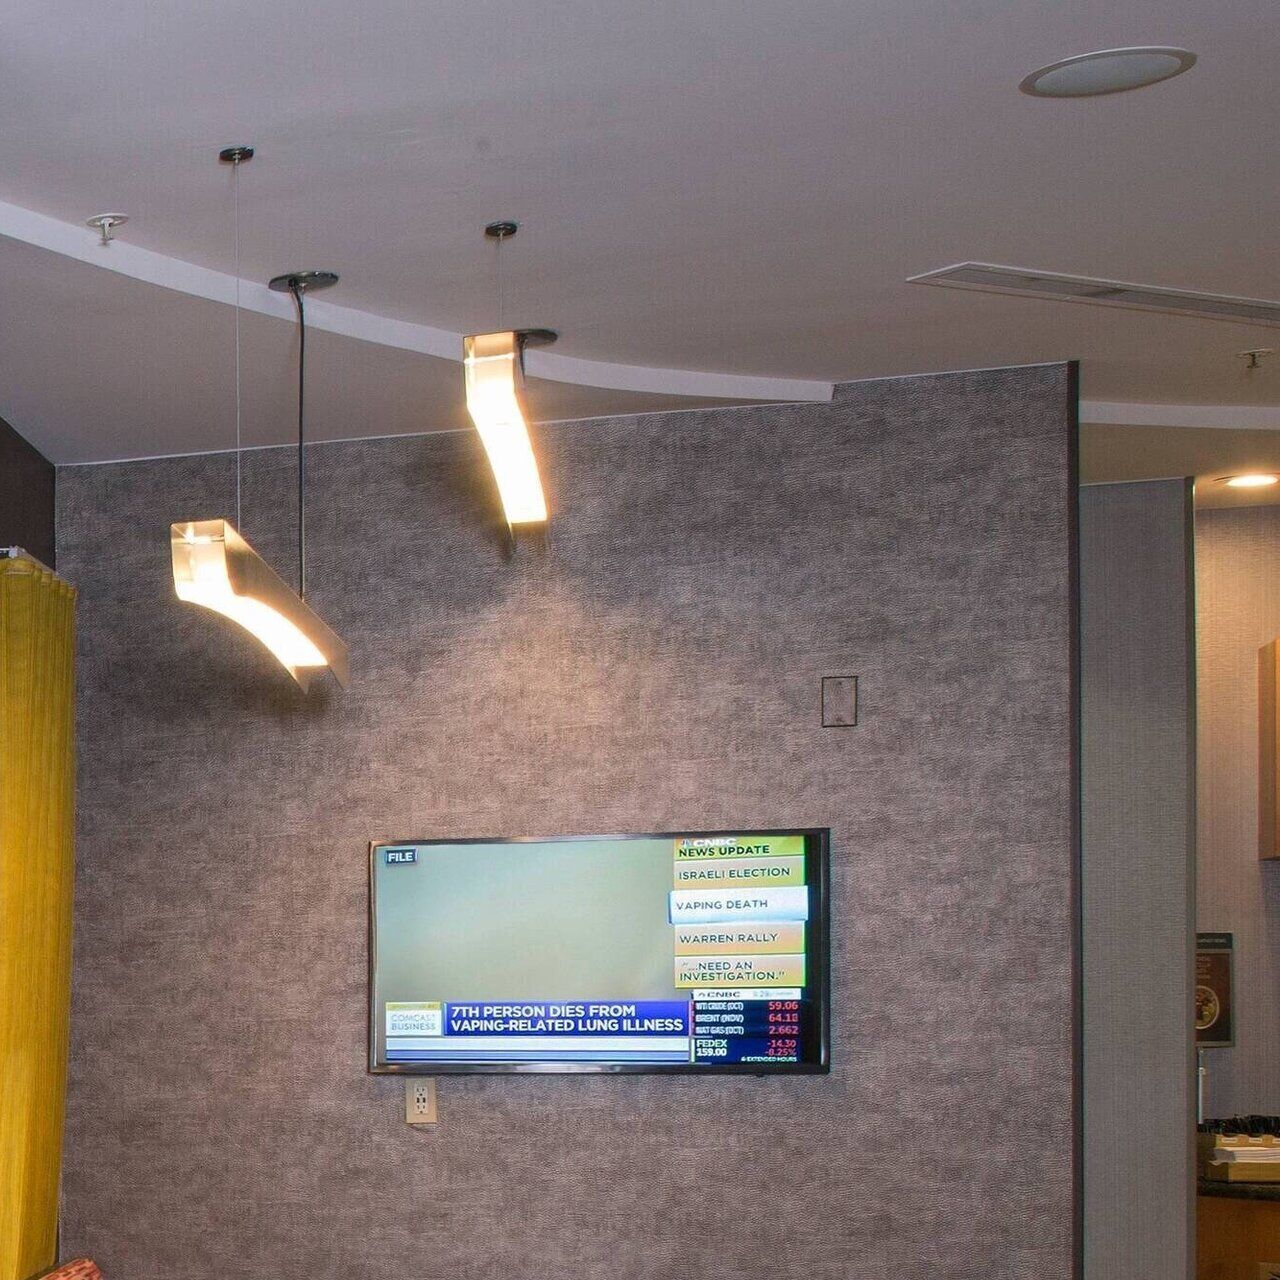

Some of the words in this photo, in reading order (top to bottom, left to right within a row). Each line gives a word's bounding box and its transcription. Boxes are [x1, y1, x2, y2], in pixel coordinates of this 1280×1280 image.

[679, 847, 715, 857] NEWS
[719, 845, 770, 855] UPDATE
[388, 852, 413, 862] FILE
[679, 870, 725, 880] ISRAELI
[729, 867, 790, 878] ELECTION
[676, 901, 722, 910] VAPING
[726, 899, 768, 909] DEATH
[680, 934, 734, 943] WARREN
[738, 933, 778, 942] RALLY
[735, 961, 753, 970] AN
[768, 1001, 799, 1011] 59.06
[451, 1006, 480, 1018] 7TH
[483, 1006, 545, 1018] PERSON
[549, 1005, 585, 1017] DIES
[589, 1005, 636, 1017] FROM
[391, 1022, 436, 1031] BUSINESS
[451, 1019, 575, 1031] VAPING-RELATED
[578, 1019, 619, 1031] LUNG
[623, 1018, 684, 1031] ILLNESS
[768, 1025, 799, 1035] 2.662
[696, 1039, 728, 1048] FEDEX
[696, 1048, 727, 1057] 159.00
